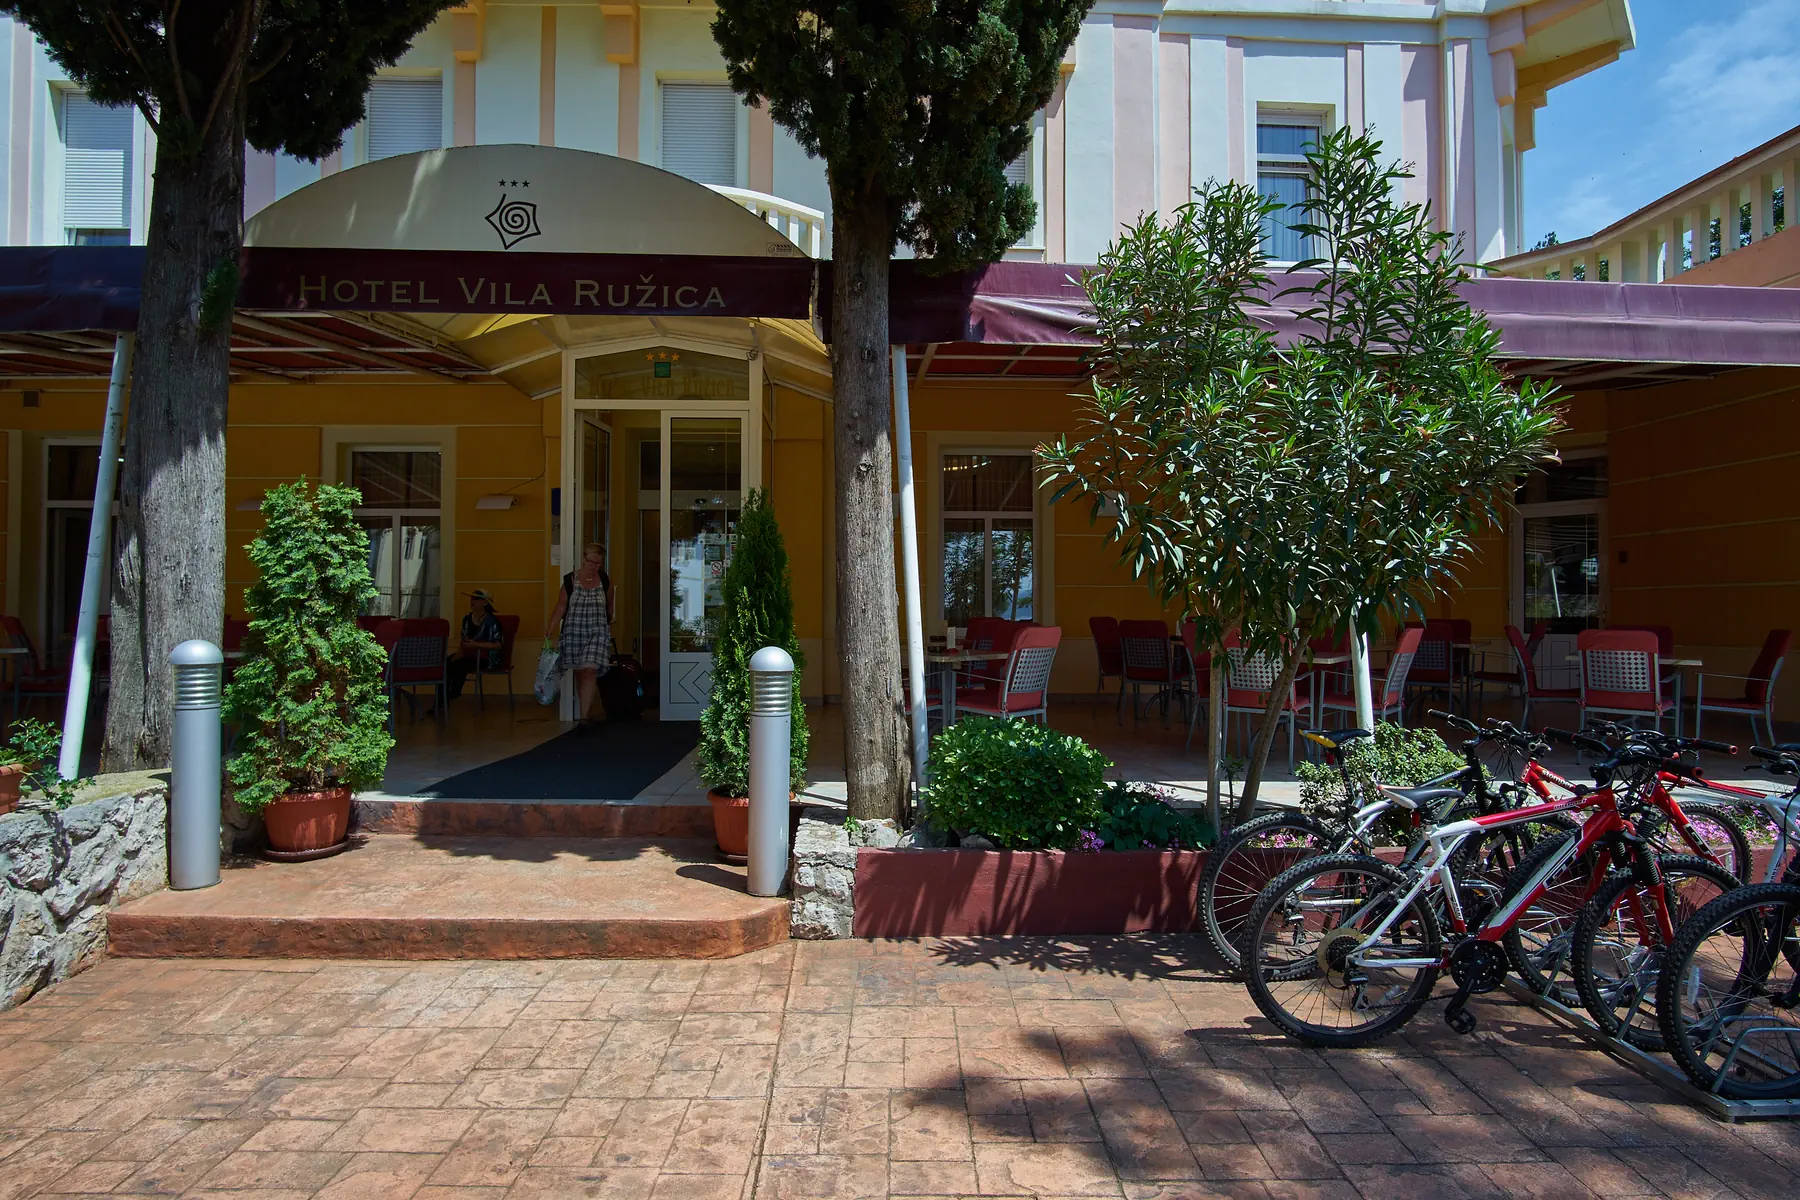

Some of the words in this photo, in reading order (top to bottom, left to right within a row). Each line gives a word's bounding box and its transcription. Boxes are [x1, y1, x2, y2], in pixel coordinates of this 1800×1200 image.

[298, 274, 439, 304] HOTEL
[458, 276, 555, 307] VILA
[574, 274, 727, 309] RUŽICA
